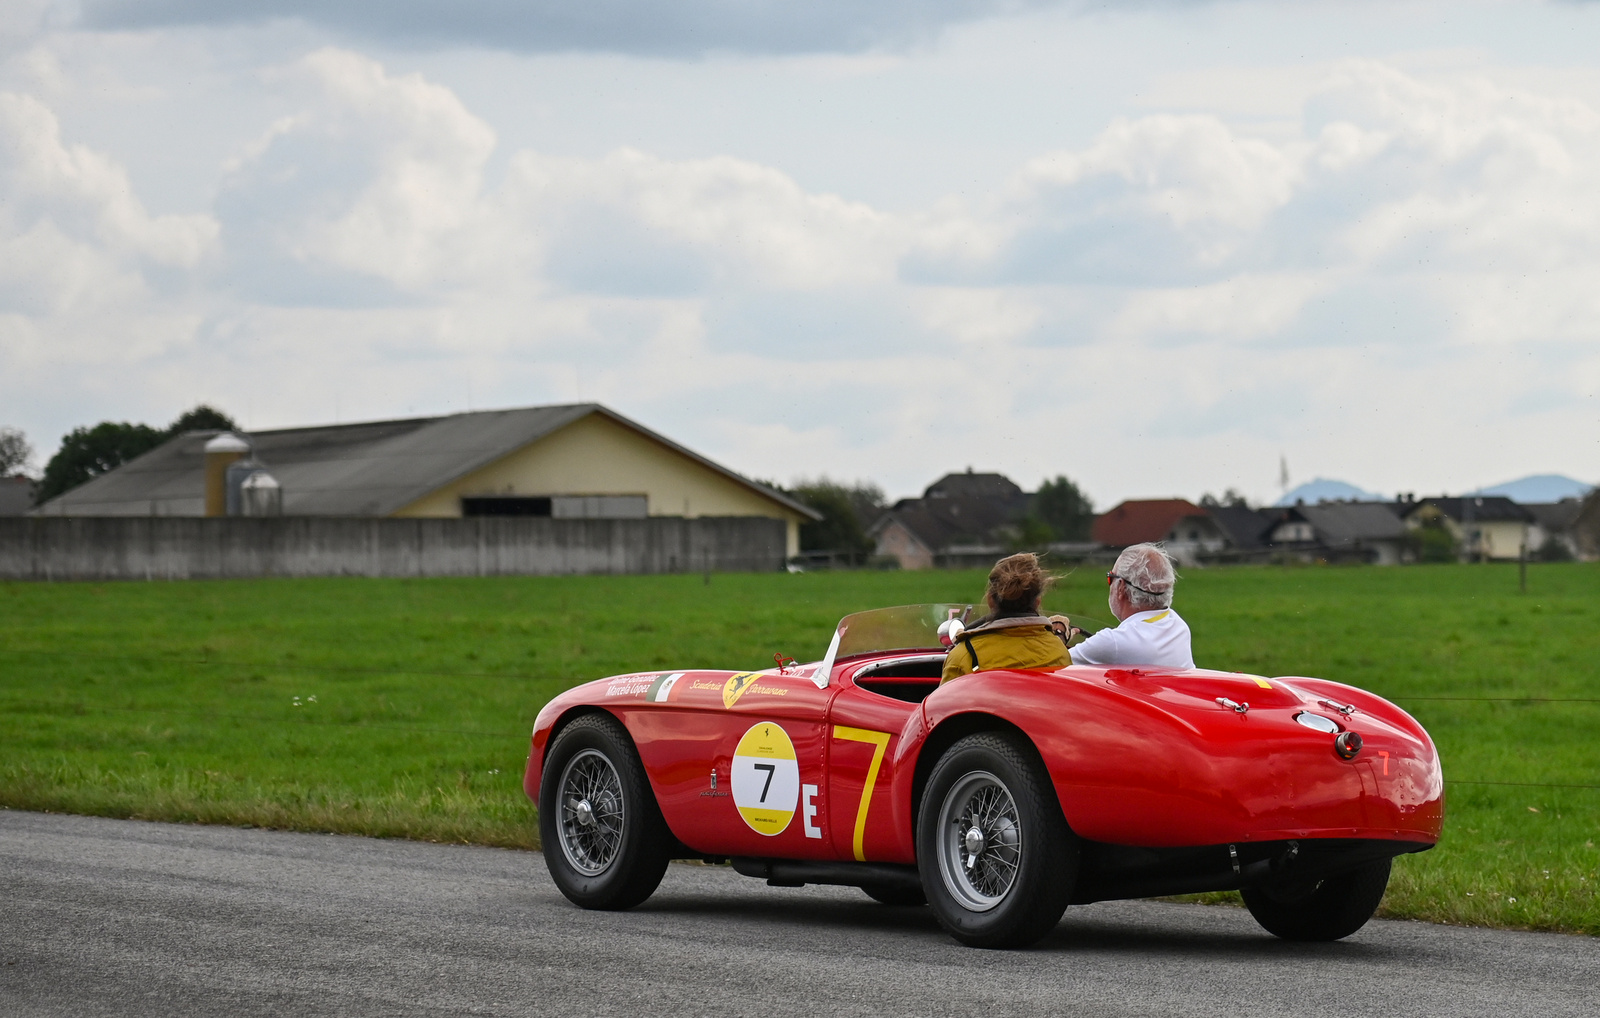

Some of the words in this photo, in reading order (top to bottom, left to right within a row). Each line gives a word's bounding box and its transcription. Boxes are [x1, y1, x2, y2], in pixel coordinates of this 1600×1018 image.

[605, 684, 631, 696] Marcela
[630, 682, 651, 697] López
[689, 679, 722, 691] Scuderia
[1378, 751, 1390, 776] 7
[754, 763, 776, 803] 7
[832, 725, 892, 862] 7
[802, 783, 822, 839] E
